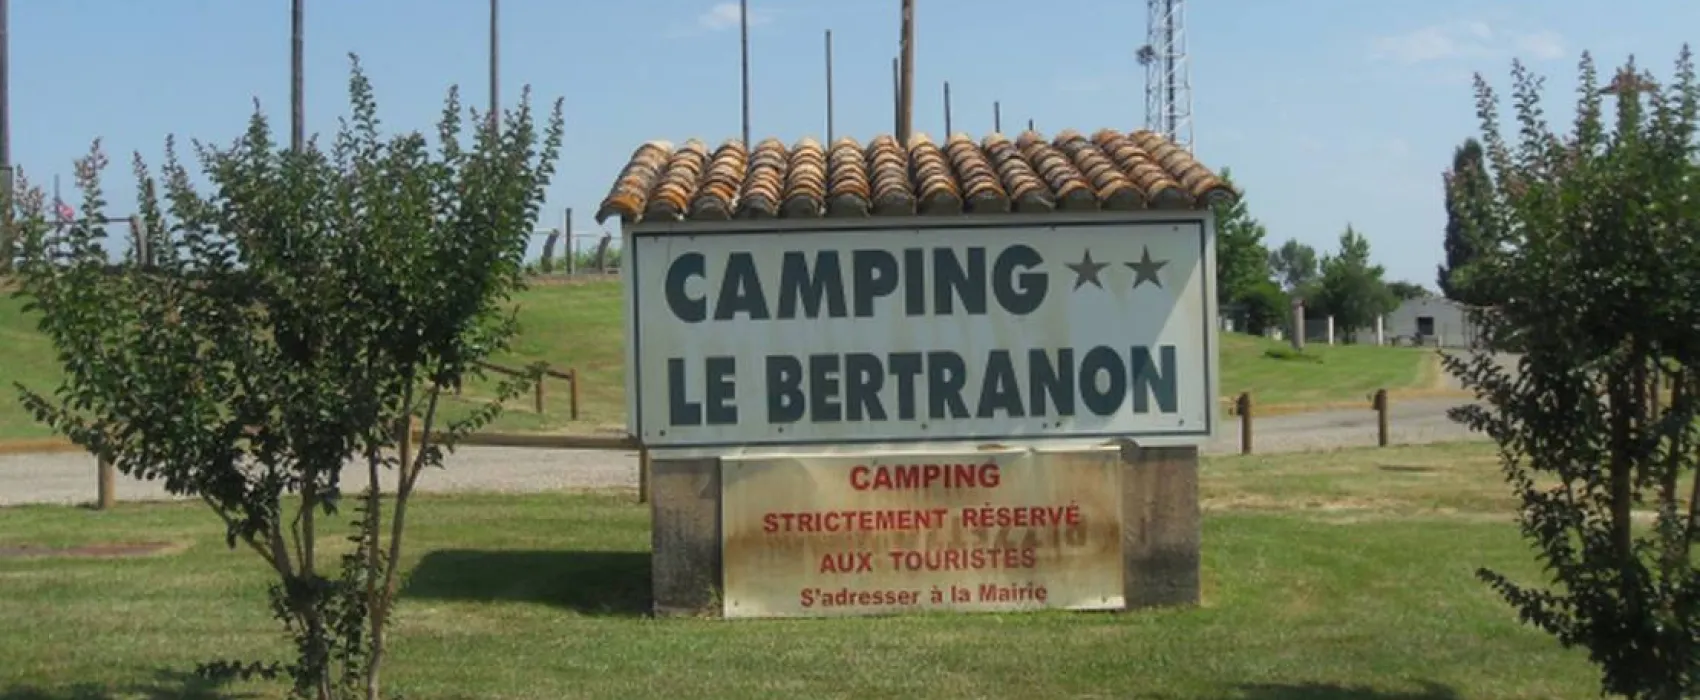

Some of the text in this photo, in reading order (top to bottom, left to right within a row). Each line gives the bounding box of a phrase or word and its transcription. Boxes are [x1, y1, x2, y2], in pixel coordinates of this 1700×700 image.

[665, 244, 1049, 323] CAMPING
[667, 345, 1177, 426] LE BERTRANON
[850, 463, 1000, 491] CAMPING
[763, 501, 1080, 533] STRICTEMENT RÉSERVÉ
[820, 548, 1036, 574] AUX TOURISTES
[800, 581, 1048, 608] S'adresser à la Mairie
